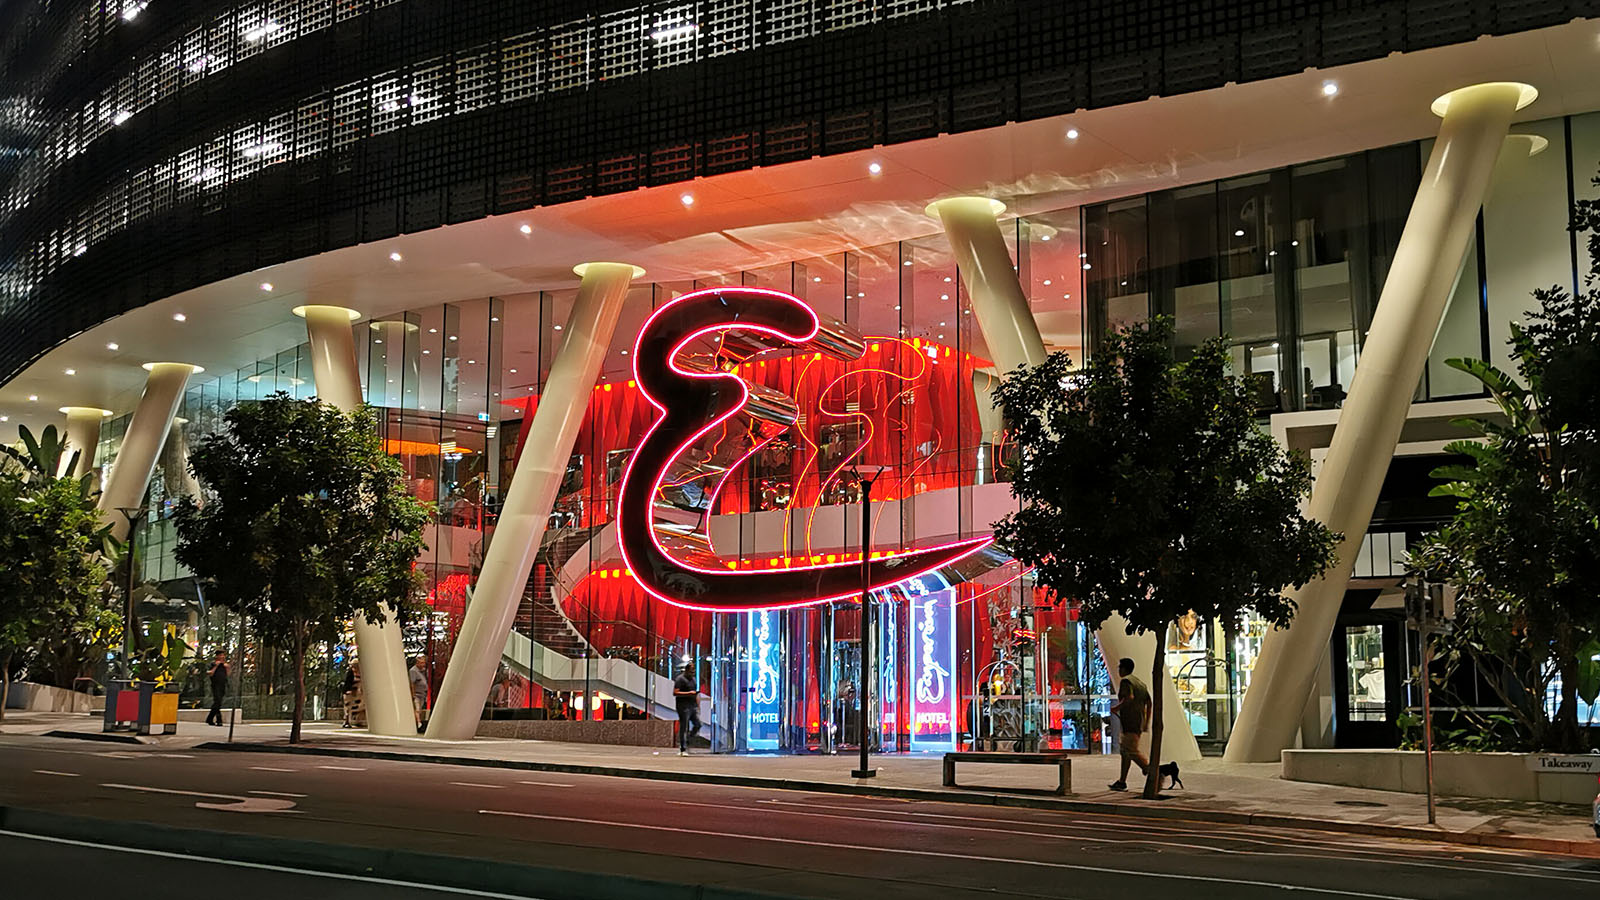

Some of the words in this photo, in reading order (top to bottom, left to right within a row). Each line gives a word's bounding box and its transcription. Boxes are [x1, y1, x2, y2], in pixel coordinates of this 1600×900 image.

[752, 713, 780, 723] HOTEL
[916, 712, 949, 723] HOTEL
[1538, 757, 1593, 771] Takeaway
